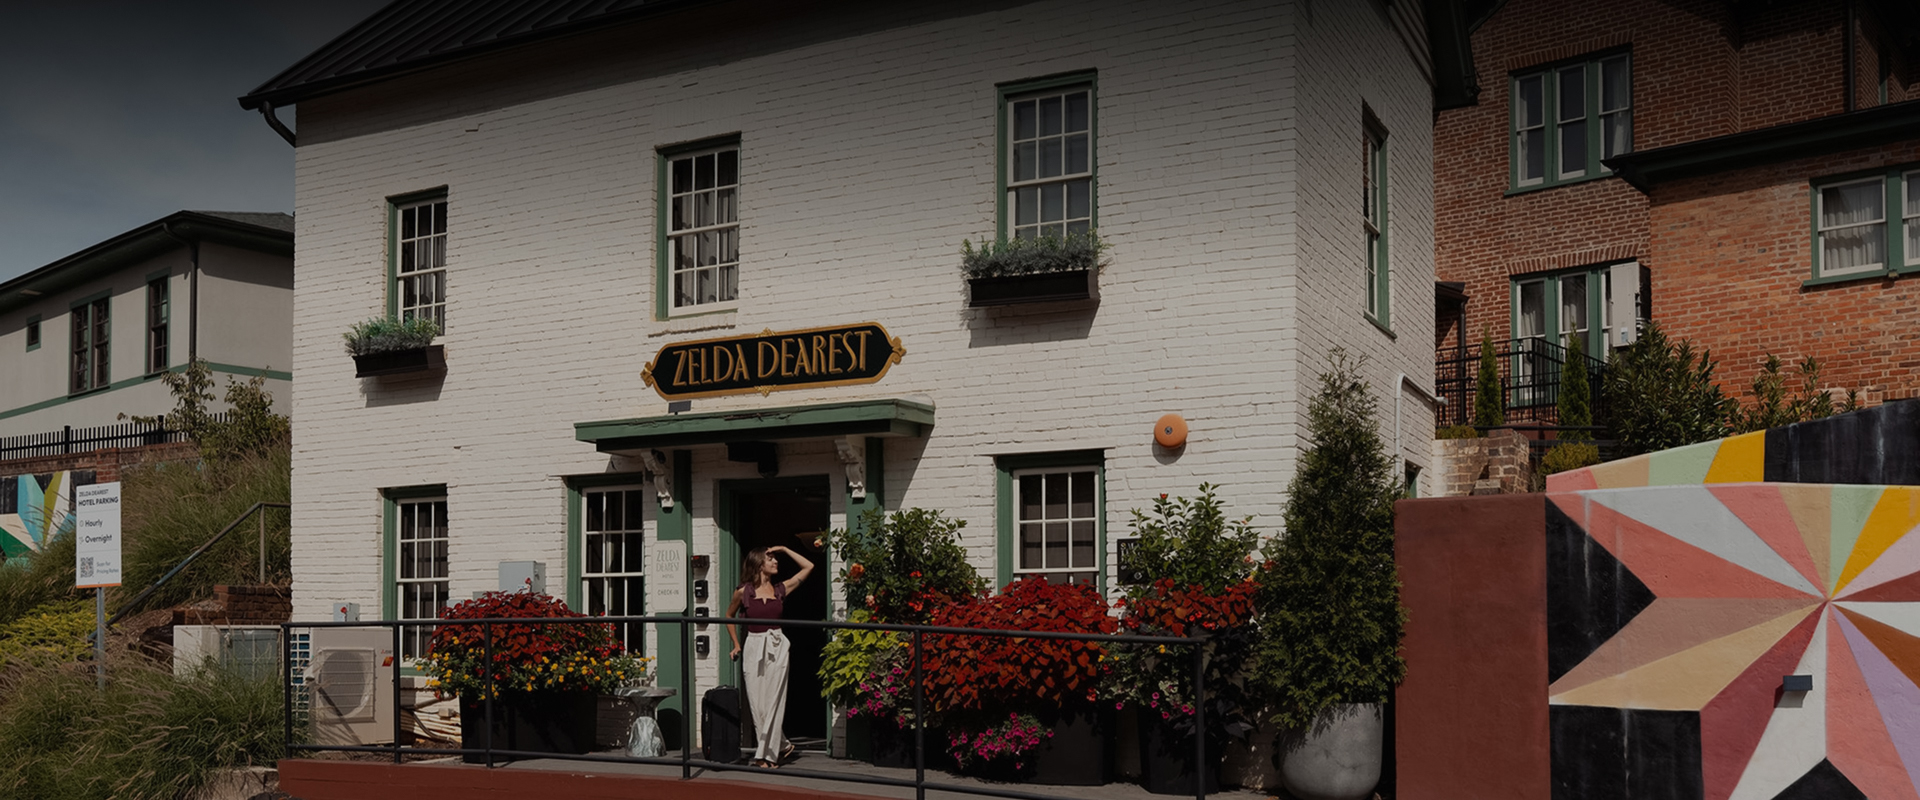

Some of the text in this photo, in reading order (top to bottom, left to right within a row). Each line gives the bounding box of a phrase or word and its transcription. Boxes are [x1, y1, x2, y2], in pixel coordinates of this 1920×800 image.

[672, 330, 873, 387] ZELDA DEAREST
[96, 496, 119, 504] PARKING
[85, 519, 103, 527] Hourly
[85, 534, 112, 544] Overnight
[656, 550, 680, 561] ZELDA
[656, 562, 680, 572] DEAREST
